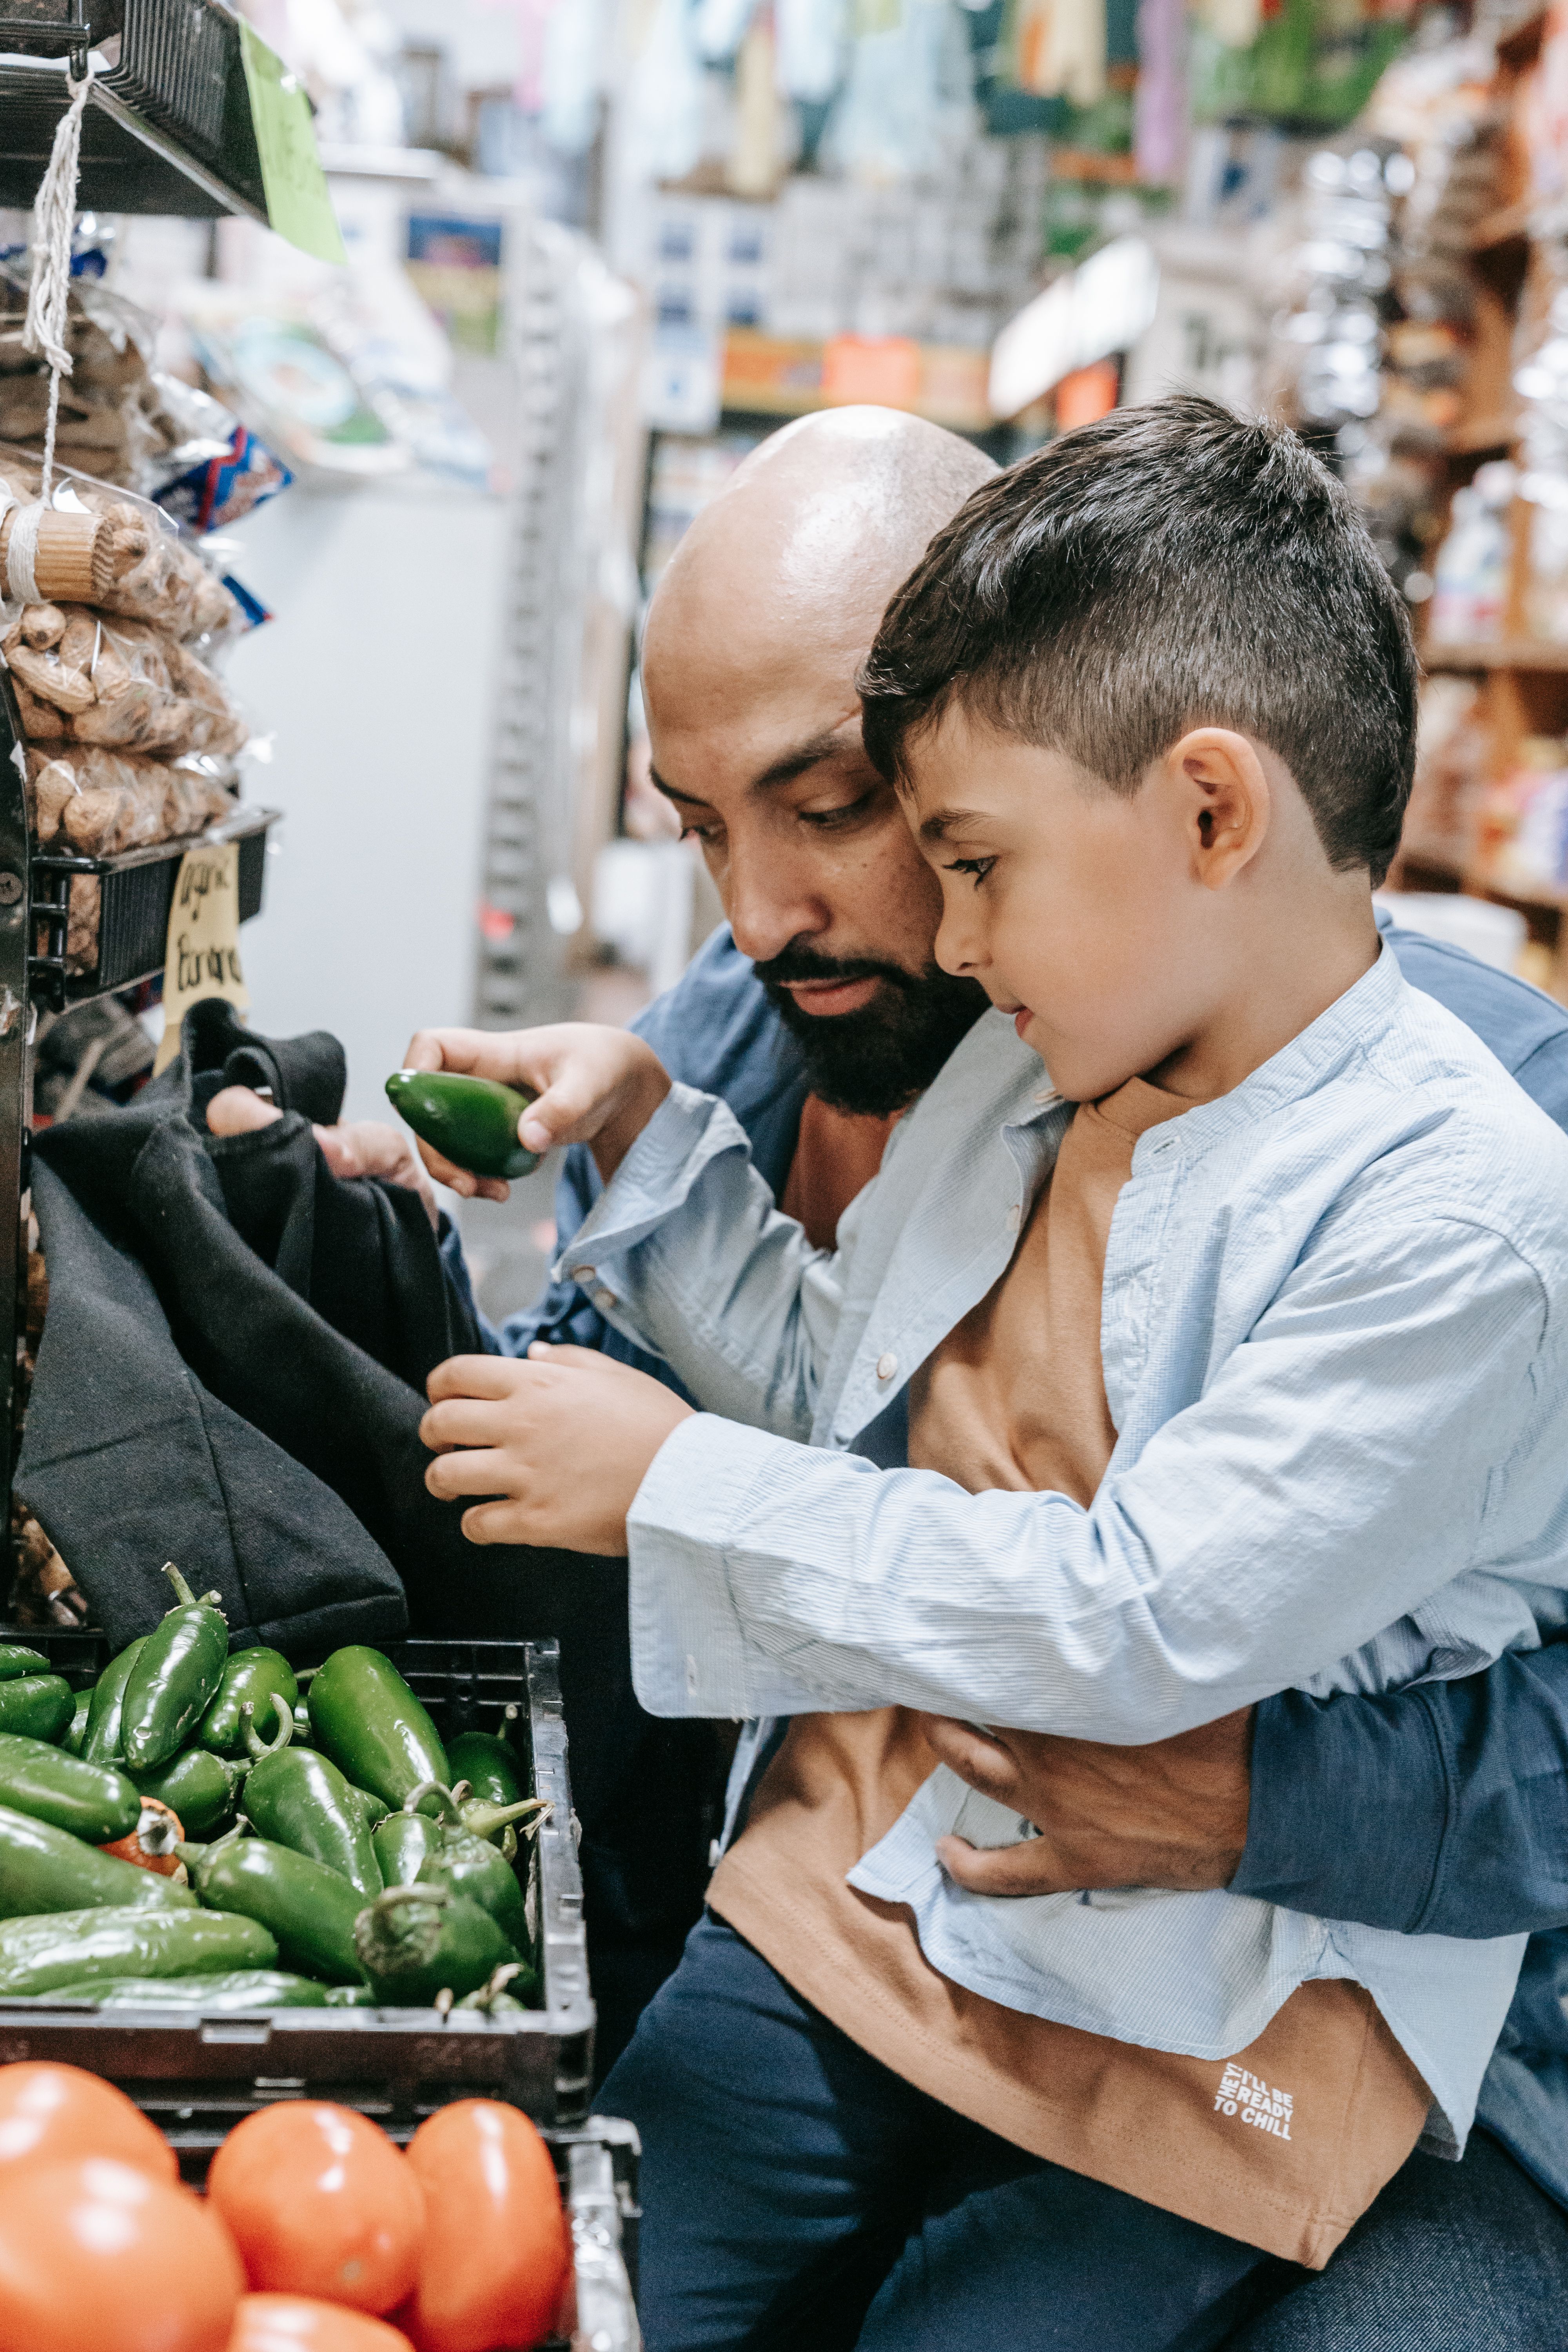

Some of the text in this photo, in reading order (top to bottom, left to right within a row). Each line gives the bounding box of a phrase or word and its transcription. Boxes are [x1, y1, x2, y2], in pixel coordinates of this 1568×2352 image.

[1217, 2062, 1243, 2099] HEY!
[1241, 2070, 1293, 2108] I'LL BE
[1214, 2096, 1292, 2141] TO CHILL
[1236, 2085, 1293, 2122] READY
